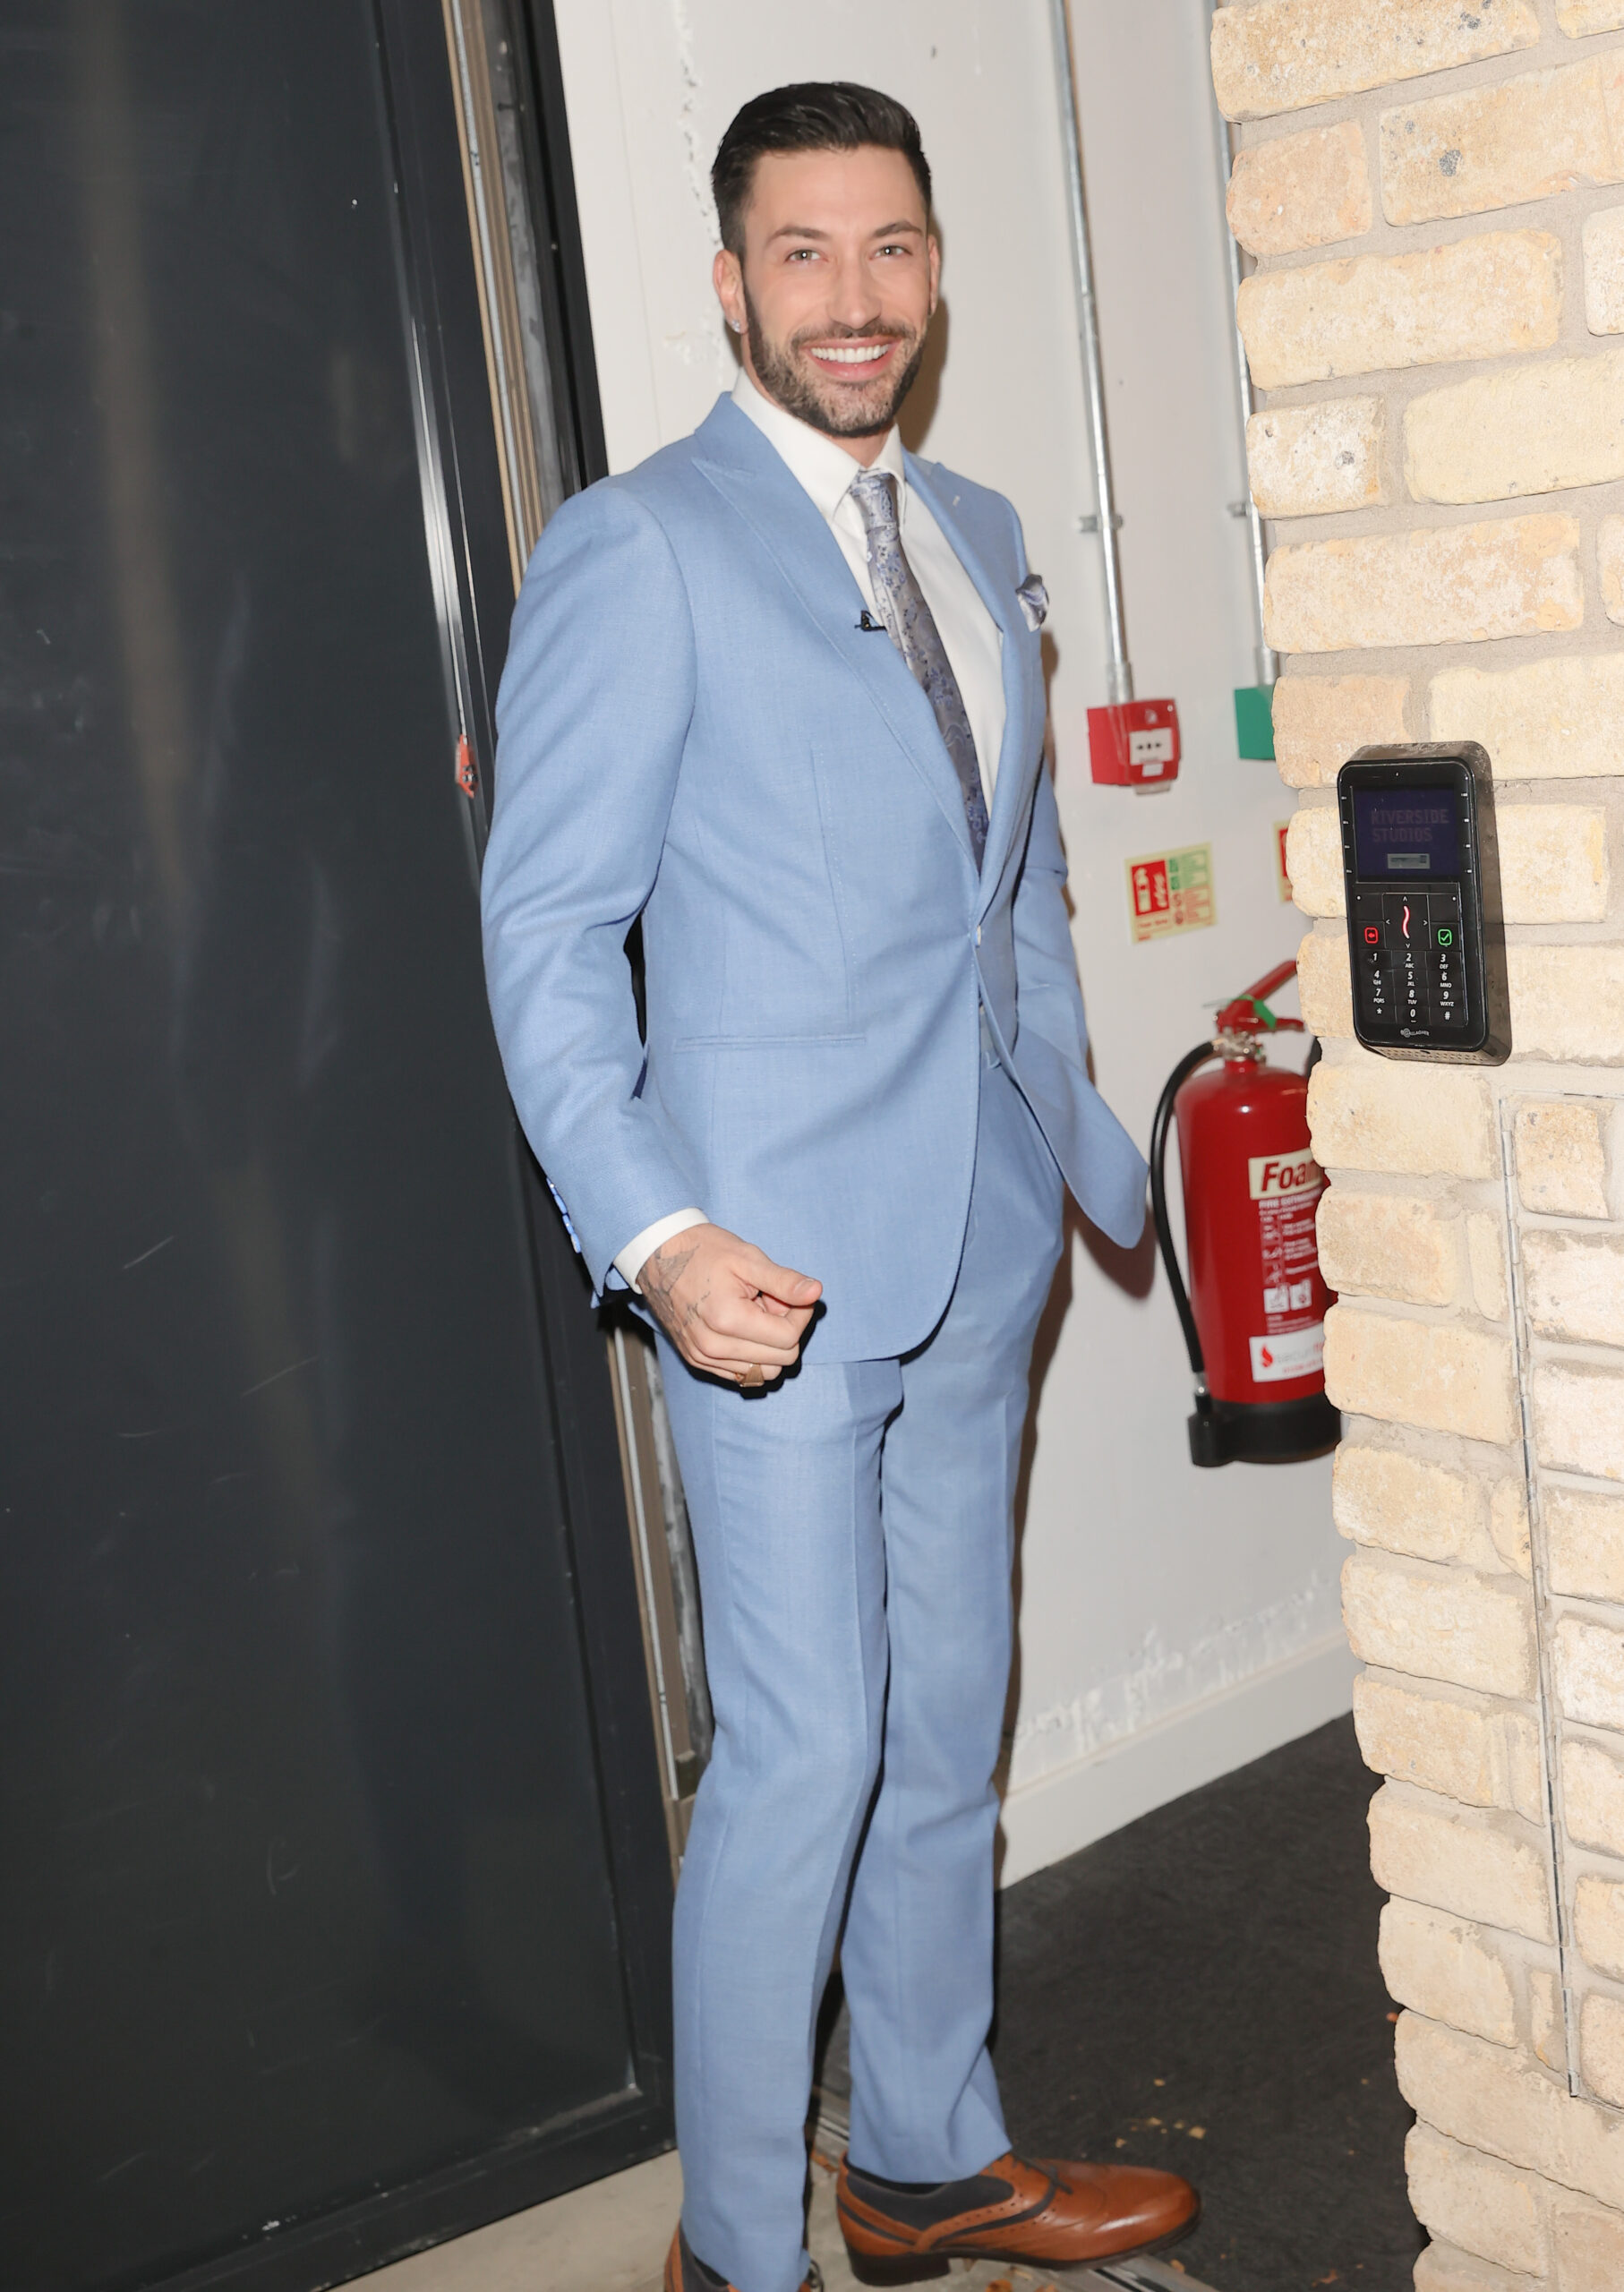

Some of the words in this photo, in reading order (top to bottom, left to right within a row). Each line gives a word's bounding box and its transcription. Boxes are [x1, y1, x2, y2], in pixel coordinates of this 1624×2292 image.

[1371, 809, 1449, 824] RIVERSIDE
[1372, 828, 1432, 842] STUDIOS
[1372, 953, 1378, 962] 1
[1406, 953, 1412, 962] 2
[1440, 954, 1447, 962] 3
[1374, 970, 1380, 979] 4
[1407, 971, 1414, 979] 5
[1441, 972, 1448, 981] 6
[1375, 988, 1381, 996] 7
[1409, 989, 1415, 998] 8
[1443, 991, 1449, 1000] 9
[1410, 1009, 1416, 1018] 0
